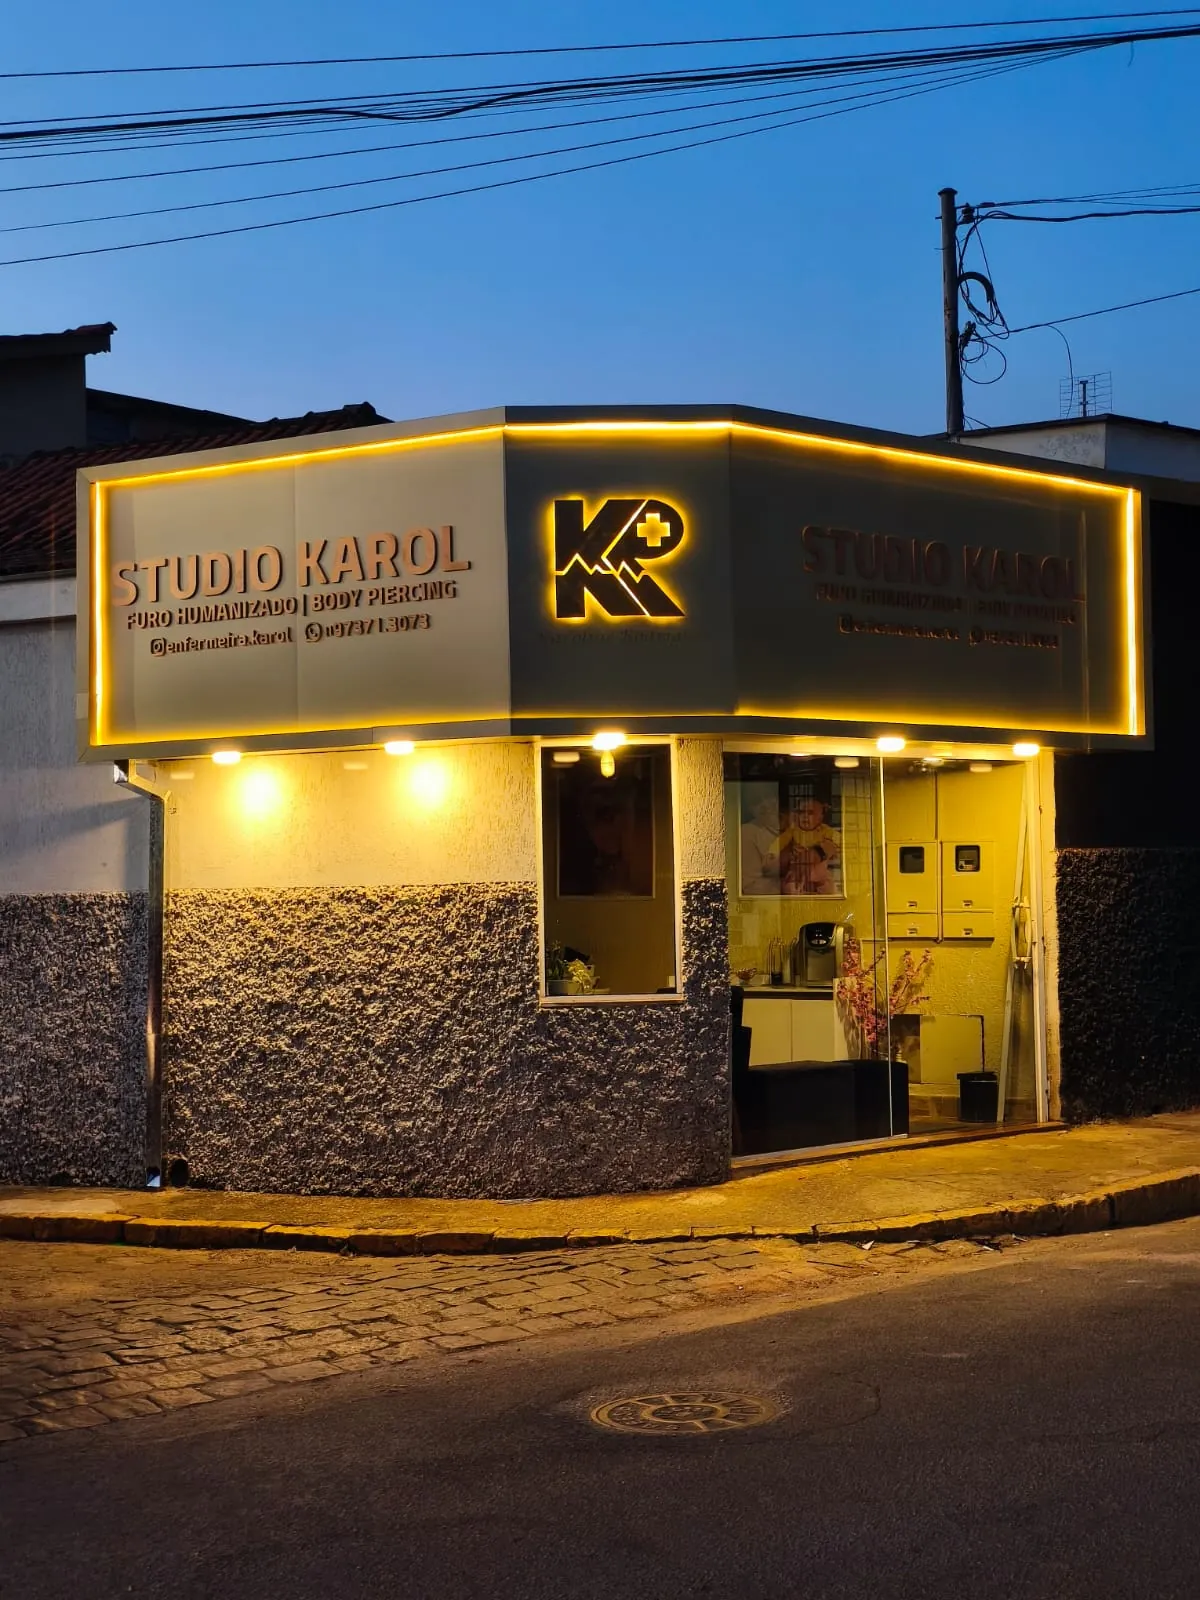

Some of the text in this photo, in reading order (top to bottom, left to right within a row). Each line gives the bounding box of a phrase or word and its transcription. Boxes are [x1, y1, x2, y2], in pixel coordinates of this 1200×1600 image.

[112, 525, 471, 606] STUDIO KAROL
[801, 525, 951, 586] STUDIO
[127, 609, 173, 630] FURO
[176, 597, 298, 625] HUMANIZADO
[312, 588, 362, 612] BODY
[367, 580, 457, 607] PIERCING
